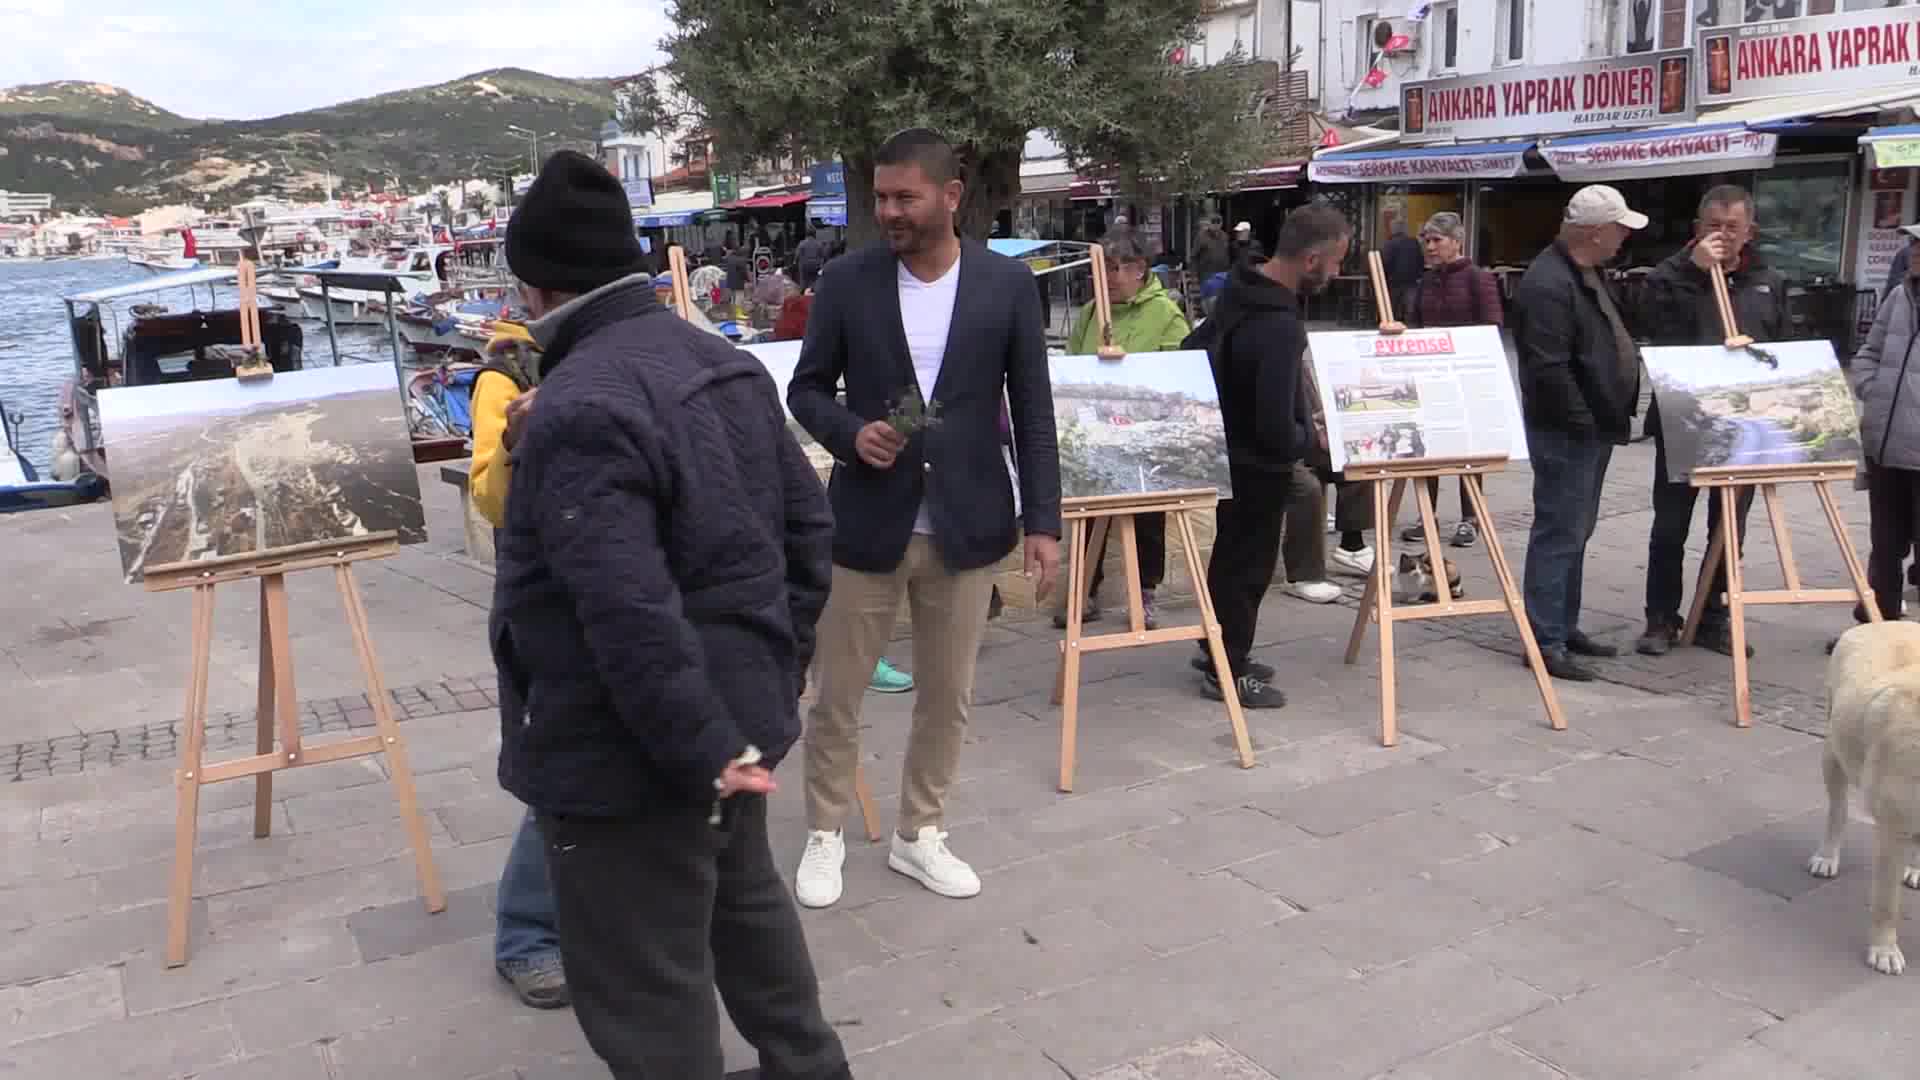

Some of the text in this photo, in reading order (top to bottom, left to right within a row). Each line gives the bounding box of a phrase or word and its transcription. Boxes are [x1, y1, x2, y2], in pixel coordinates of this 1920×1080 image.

[1737, 32, 1822, 81] ANKARA
[1827, 22, 1910, 70] YAPRAK
[1428, 64, 1654, 123] ANKARA YAPRAK DÖNER
[1573, 109, 1654, 124] HAYDAR USTA
[1376, 336, 1455, 356] evrensel
